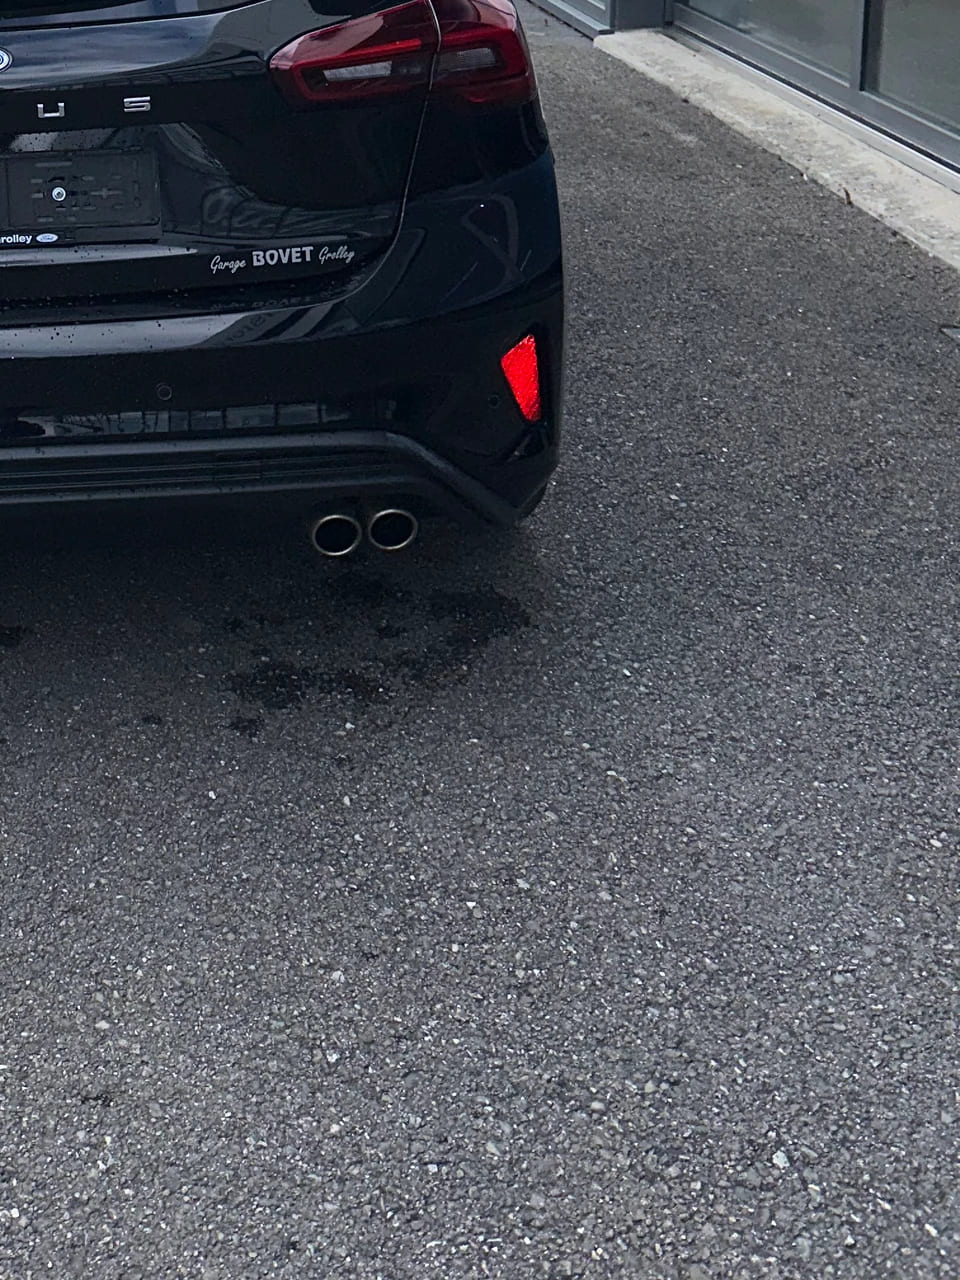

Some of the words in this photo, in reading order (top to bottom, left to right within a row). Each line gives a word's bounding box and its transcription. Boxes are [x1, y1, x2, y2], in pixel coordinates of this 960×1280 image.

[210, 255, 246, 274] Garage
[252, 246, 314, 266] BOVET
[318, 245, 355, 265] Grolley
